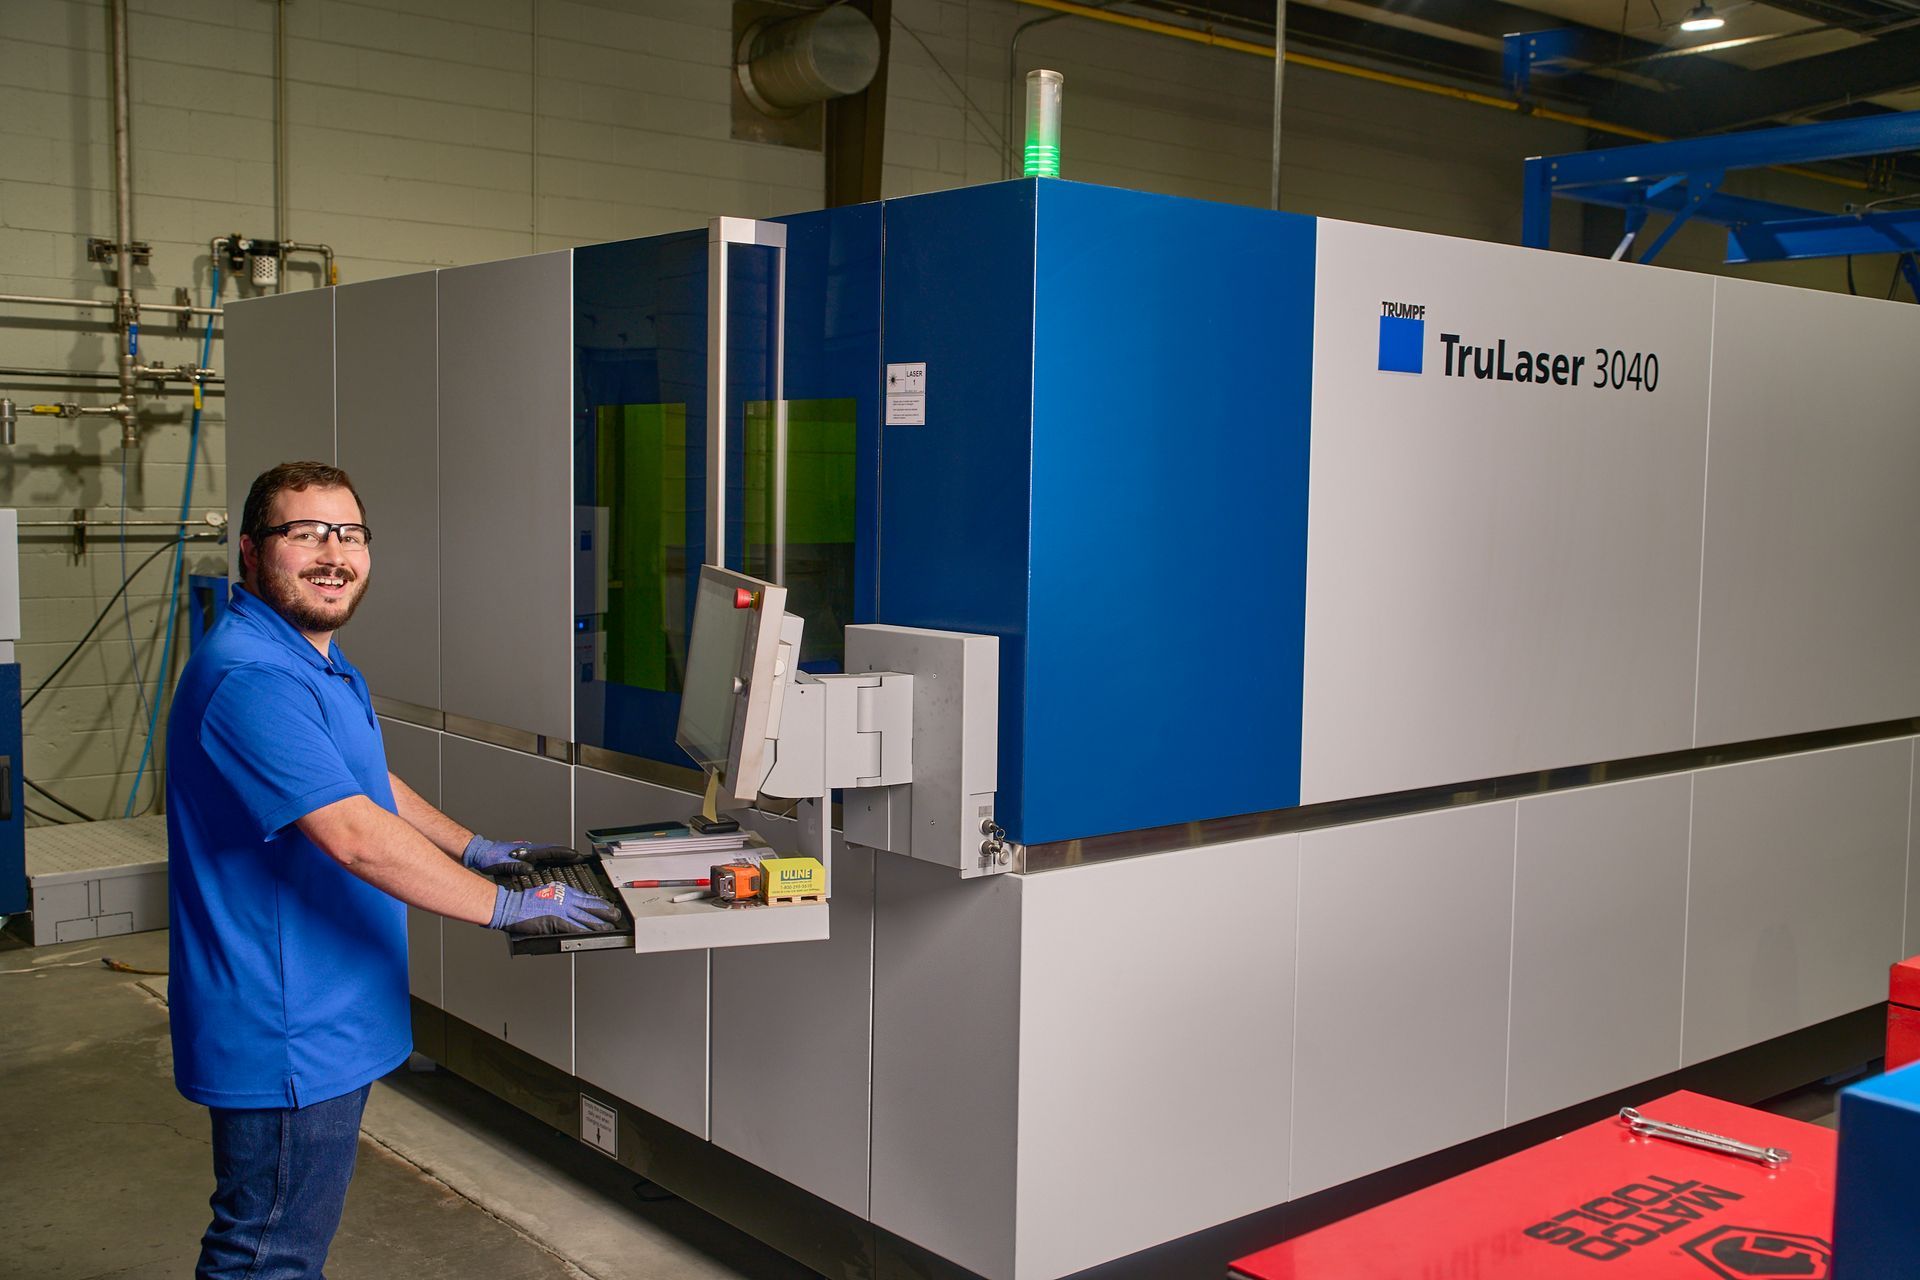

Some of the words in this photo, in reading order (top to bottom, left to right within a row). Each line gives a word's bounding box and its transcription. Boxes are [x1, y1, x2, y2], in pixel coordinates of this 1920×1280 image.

[1382, 301, 1425, 320] TRUMPF
[906, 370, 923, 378] LASER
[1440, 333, 1585, 386] TruLaser
[1593, 348, 1659, 392] 3040
[782, 868, 811, 880] ULINE
[1523, 1175, 1702, 1245] TOOLS
[1568, 1184, 1745, 1261] MATCO
